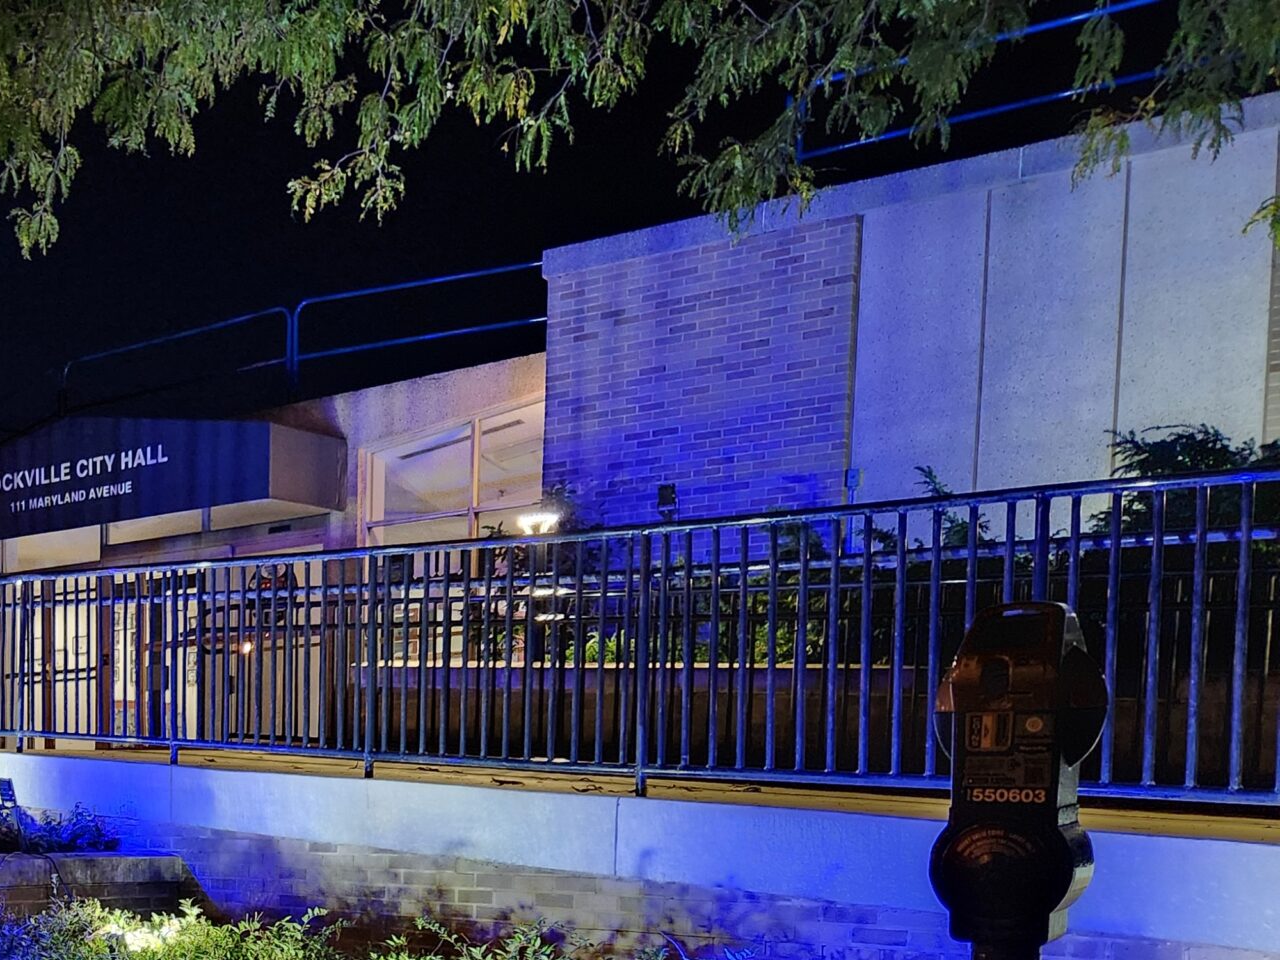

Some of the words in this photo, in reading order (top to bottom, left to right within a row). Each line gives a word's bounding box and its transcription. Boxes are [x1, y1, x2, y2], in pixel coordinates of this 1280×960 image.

[76, 453, 117, 478] CITY
[120, 444, 168, 471] HALL
[10, 500, 26, 513] 111
[28, 489, 87, 511] MARYLAND
[88, 480, 133, 500] AVENUE
